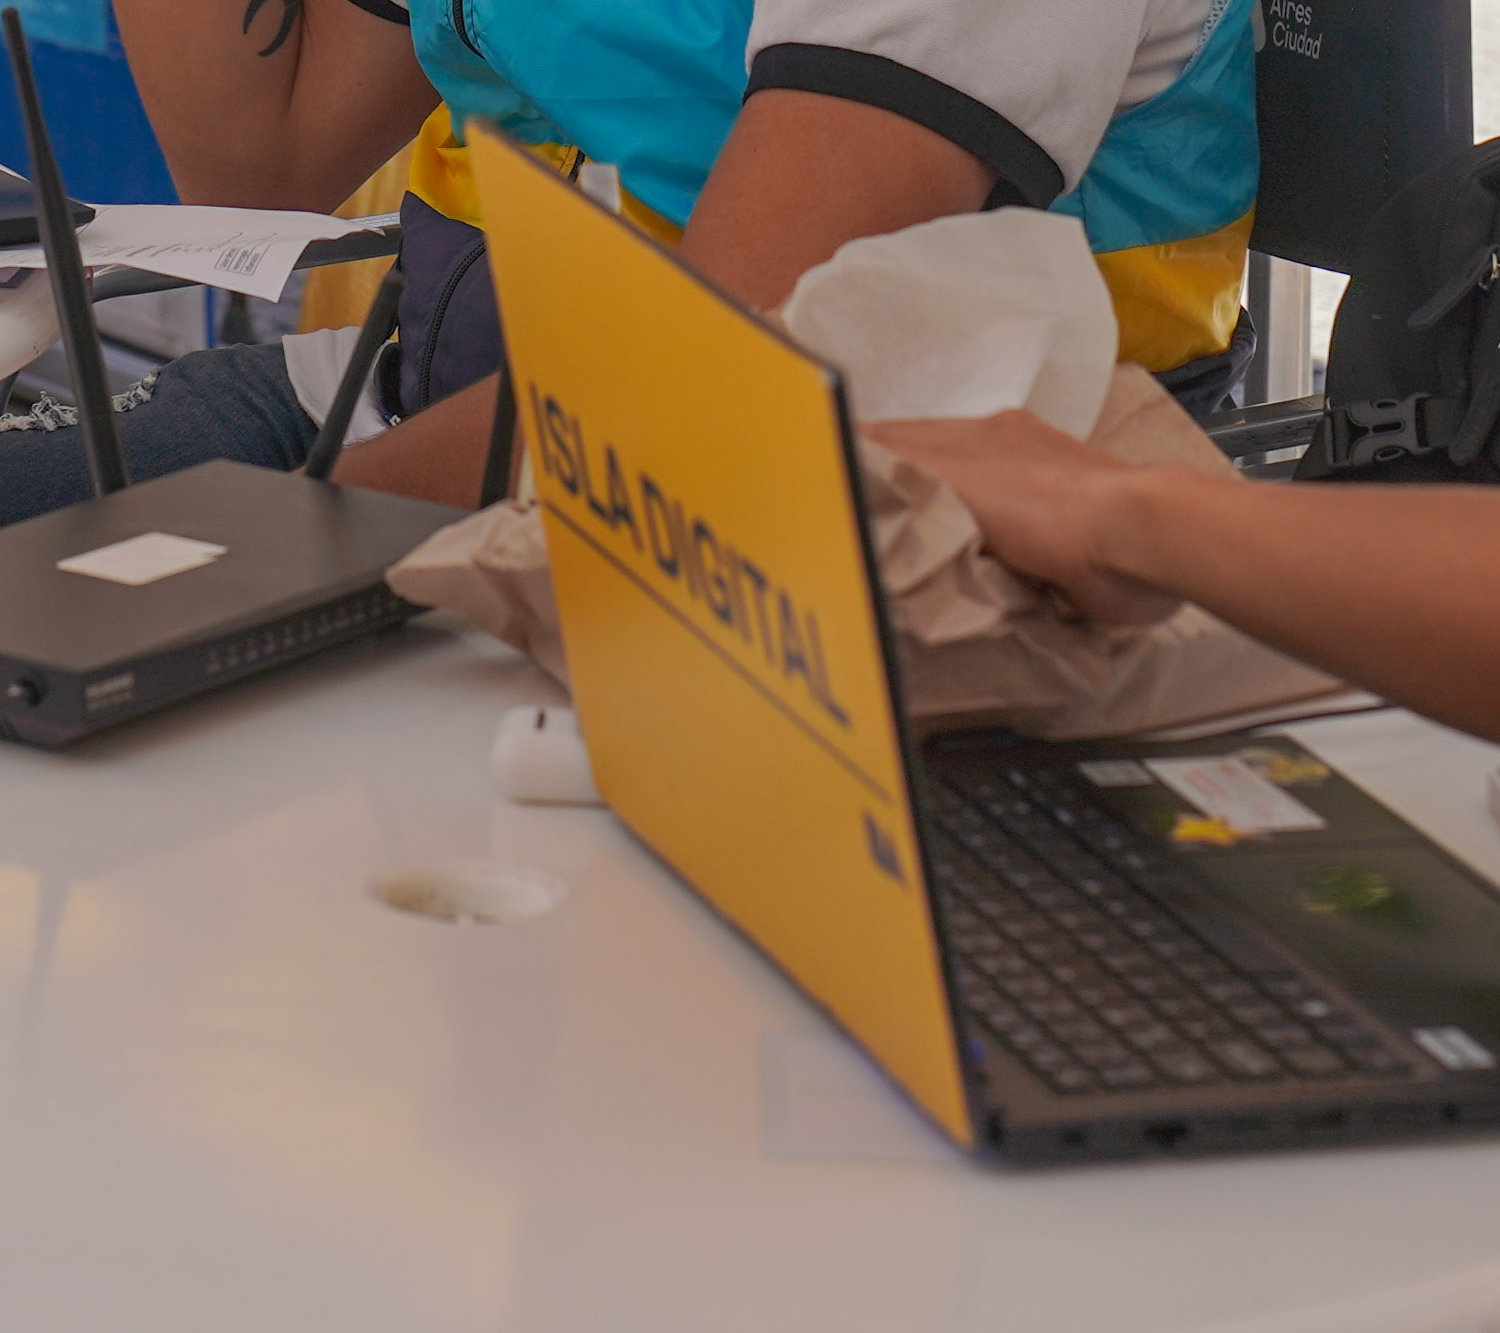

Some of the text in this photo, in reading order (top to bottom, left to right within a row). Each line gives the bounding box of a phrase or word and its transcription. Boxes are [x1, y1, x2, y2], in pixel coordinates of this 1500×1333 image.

[1272, 20, 1323, 60] Ciudad
[527, 379, 852, 731] ISLA DIGITAL
